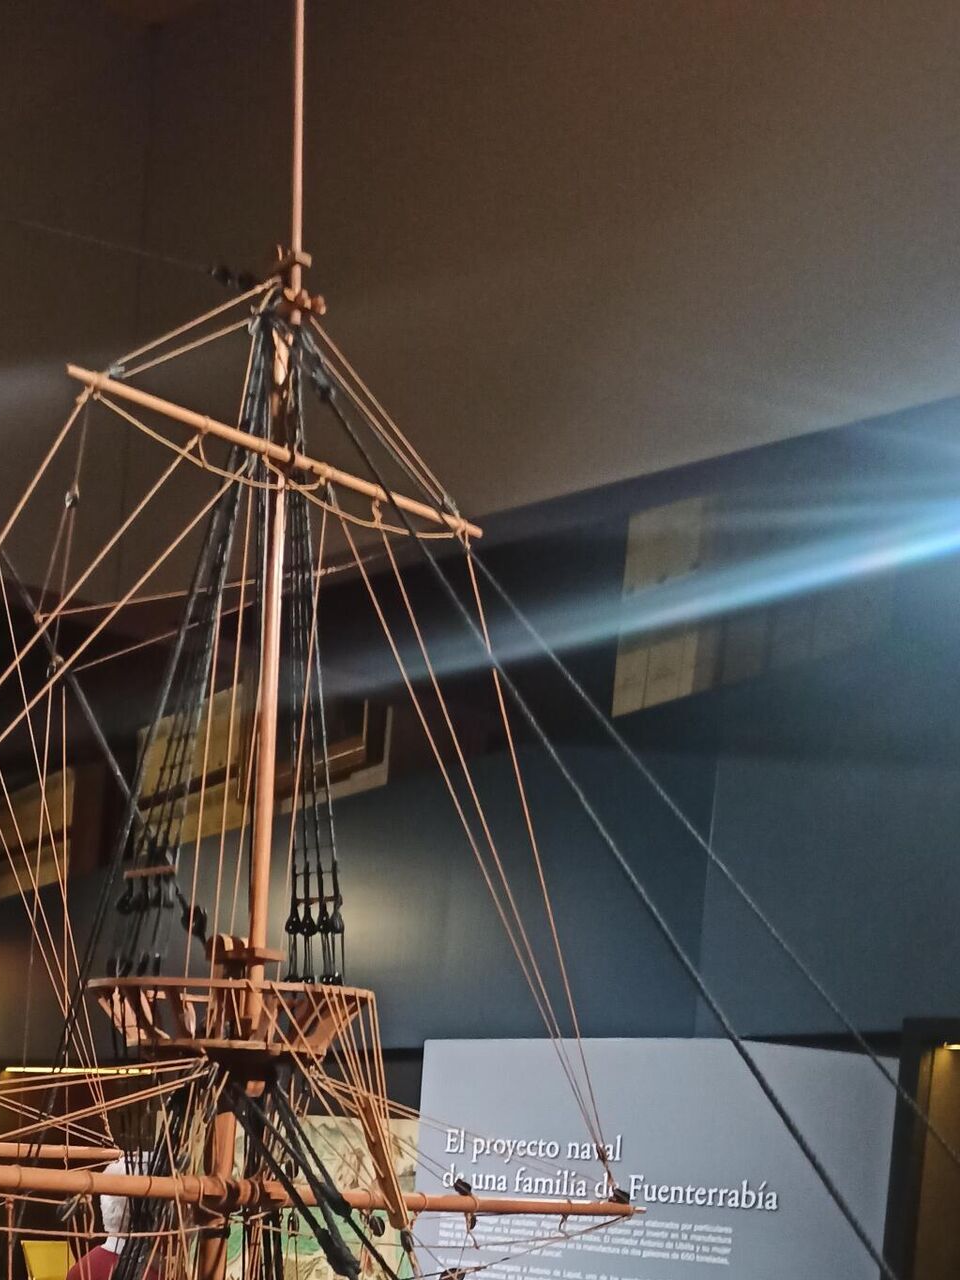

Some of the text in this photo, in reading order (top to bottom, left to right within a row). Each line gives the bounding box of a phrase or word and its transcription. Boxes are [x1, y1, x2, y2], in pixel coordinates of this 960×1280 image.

[445, 1128, 623, 1164] El proyecto naval
[472, 1171, 508, 1192] una
[514, 1167, 587, 1198] familia
[628, 1174, 779, 1211] Fuenterrabía
